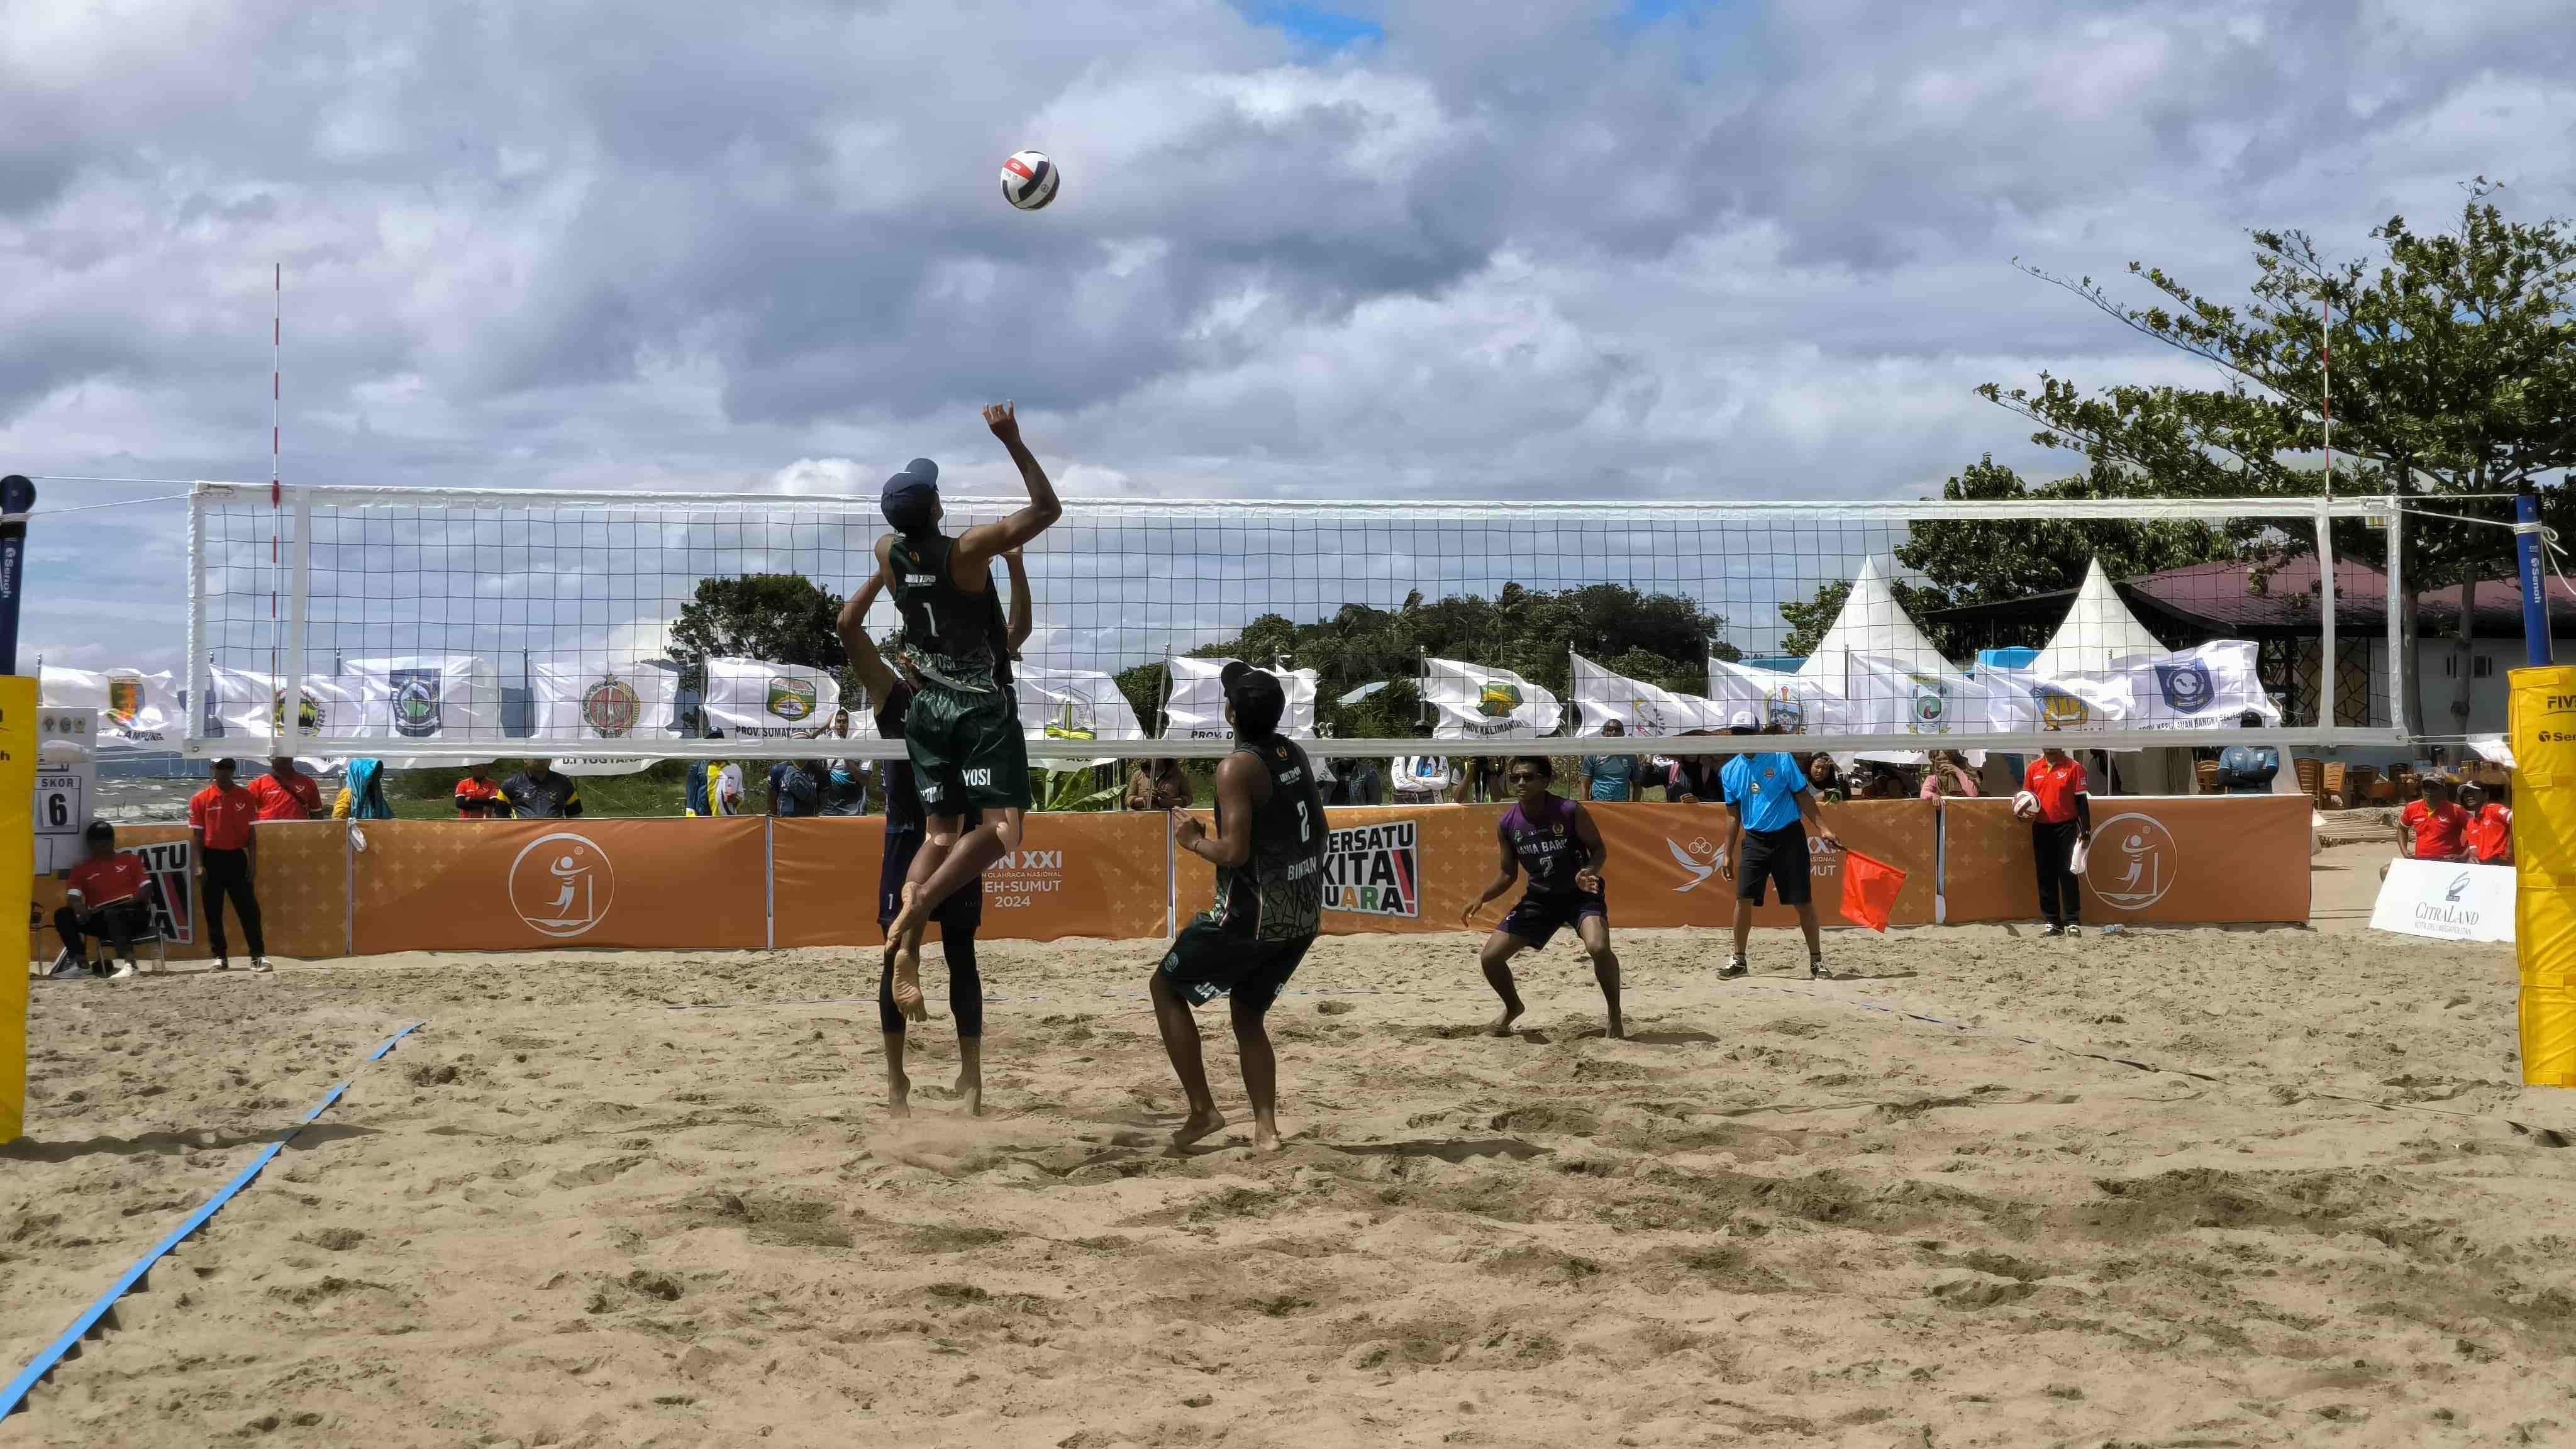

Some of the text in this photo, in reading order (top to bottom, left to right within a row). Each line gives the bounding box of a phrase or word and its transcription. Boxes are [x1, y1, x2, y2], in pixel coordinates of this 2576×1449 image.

[2531, 568, 2541, 603] Senoh
[922, 602, 939, 636] 1
[42, 778, 74, 787] SKOR
[962, 768, 991, 786] YOSI
[49, 793, 67, 826] 6
[1297, 801, 1309, 843] 2
[1326, 823, 1413, 853] ERSATU
[1021, 850, 1062, 869] XXI
[982, 880, 1062, 892] EH-SUMUT
[888, 893, 894, 910] 1
[995, 896, 1031, 908] 2024
